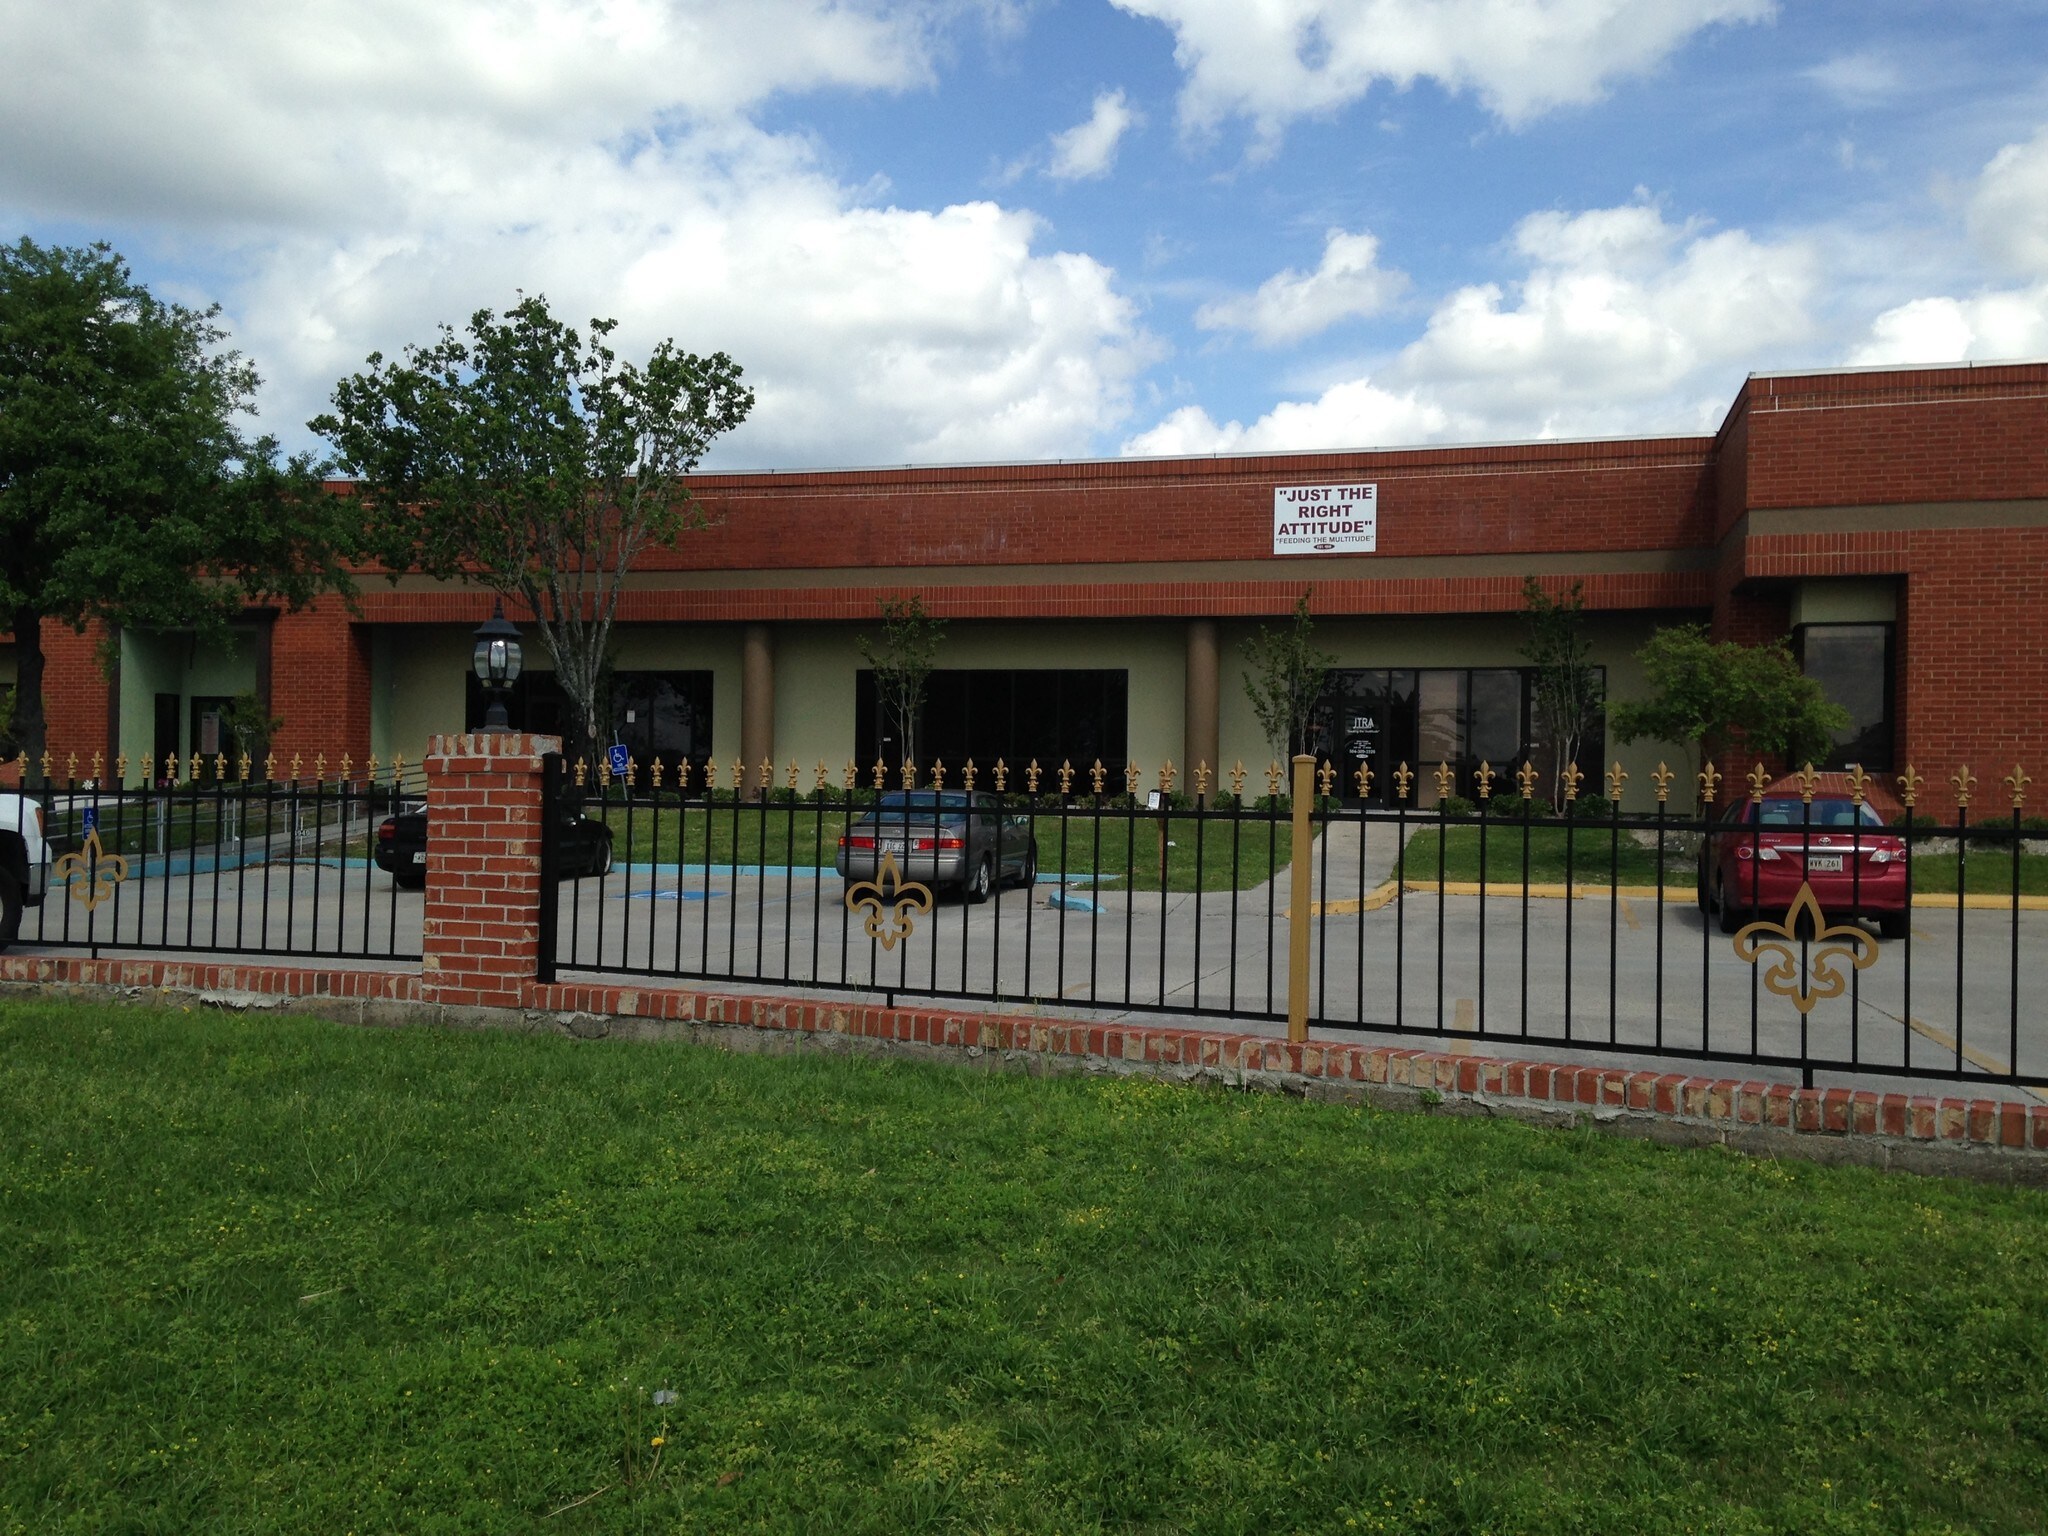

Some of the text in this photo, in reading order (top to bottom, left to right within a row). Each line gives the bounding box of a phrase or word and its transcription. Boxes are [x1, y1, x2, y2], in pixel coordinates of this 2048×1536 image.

[1279, 487, 1373, 502] "JUST THE
[1298, 504, 1353, 519] RIGHT
[1278, 520, 1373, 536] ATTITUDE"
[1328, 535, 1375, 543] MULTITUDE"
[1826, 859, 1839, 868] 261
